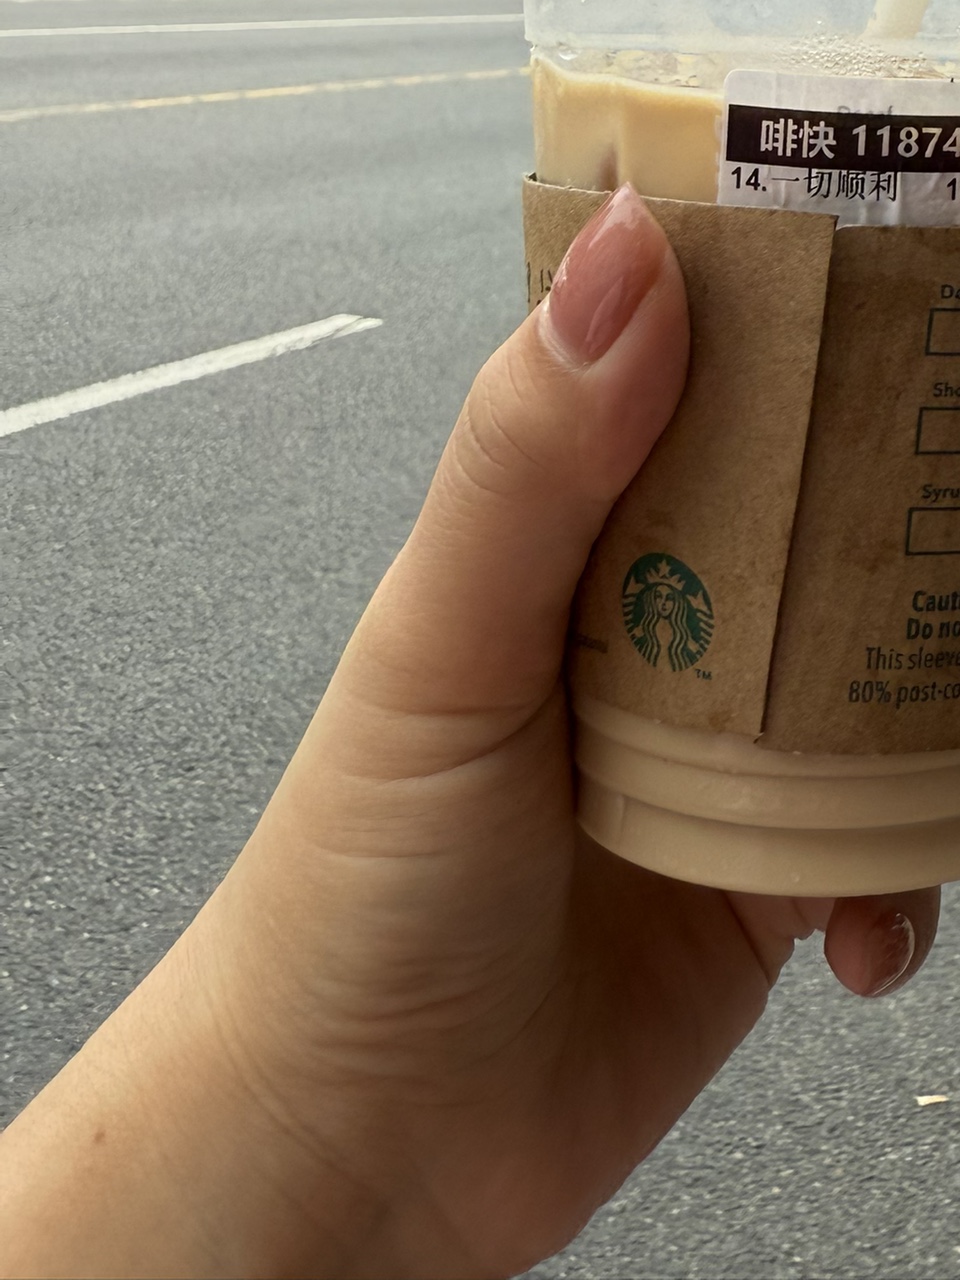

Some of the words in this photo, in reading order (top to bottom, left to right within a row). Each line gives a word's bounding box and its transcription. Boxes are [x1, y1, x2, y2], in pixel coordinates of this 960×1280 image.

[760, 118, 837, 160] 啡快
[906, 618, 934, 640] Do
[865, 646, 907, 670] This
[848, 680, 892, 704] 80%
